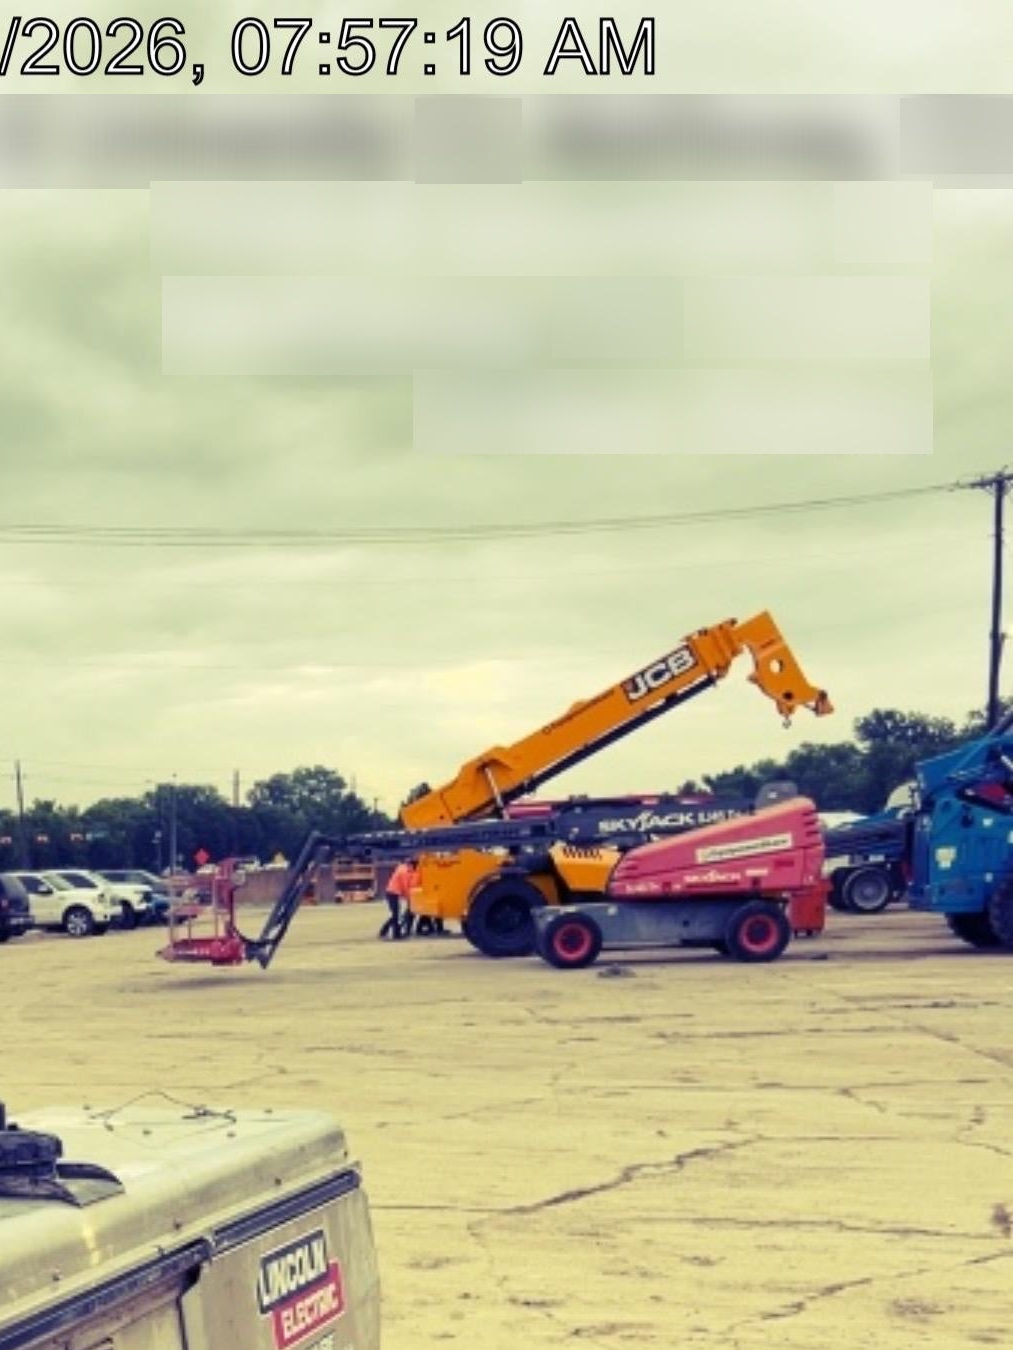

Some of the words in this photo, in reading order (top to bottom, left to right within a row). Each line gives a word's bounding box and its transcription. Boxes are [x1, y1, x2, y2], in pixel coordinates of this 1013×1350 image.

[627, 647, 695, 700] JCB
[599, 810, 694, 833] SKYJACK
[261, 1238, 327, 1306] LINCOLN
[280, 1282, 339, 1340] ELECTRIC
